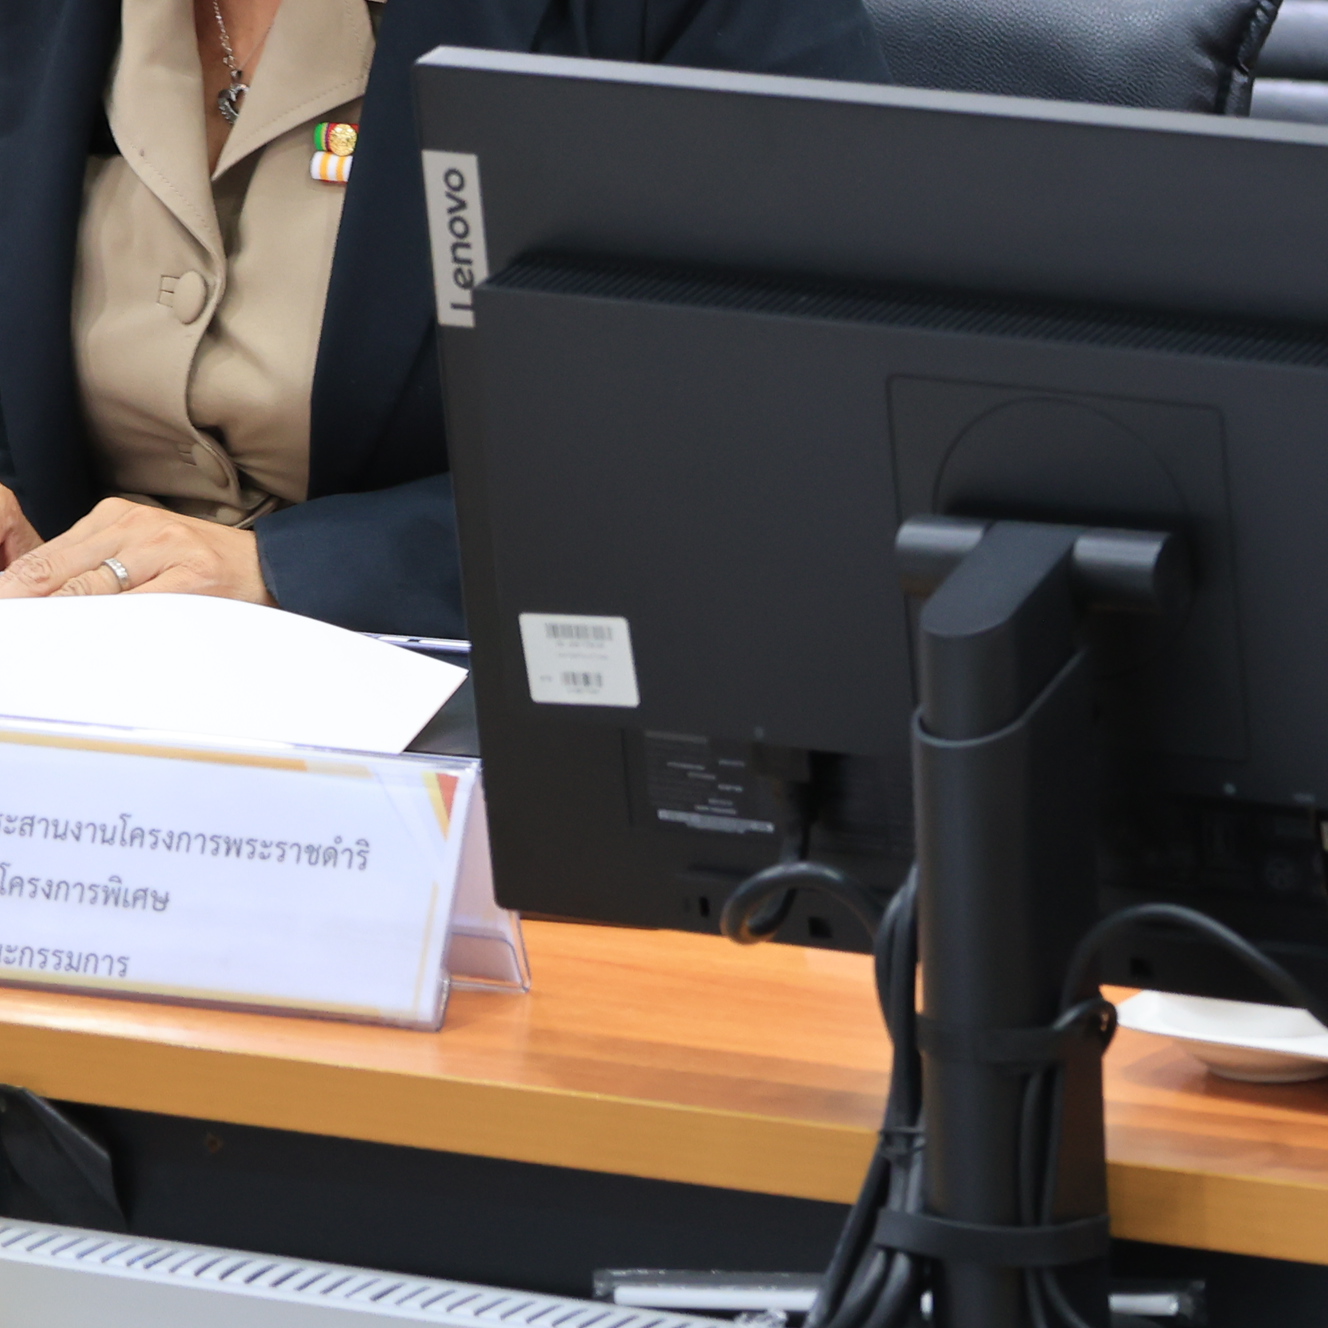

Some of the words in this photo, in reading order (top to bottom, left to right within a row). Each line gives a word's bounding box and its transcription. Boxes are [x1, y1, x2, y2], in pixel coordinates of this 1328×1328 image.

[444, 167, 476, 312] Lenovo
[0, 812, 370, 872] ะสานงานโครงการพระราชดำริ
[0, 942, 130, 979] ะกรรมการ
